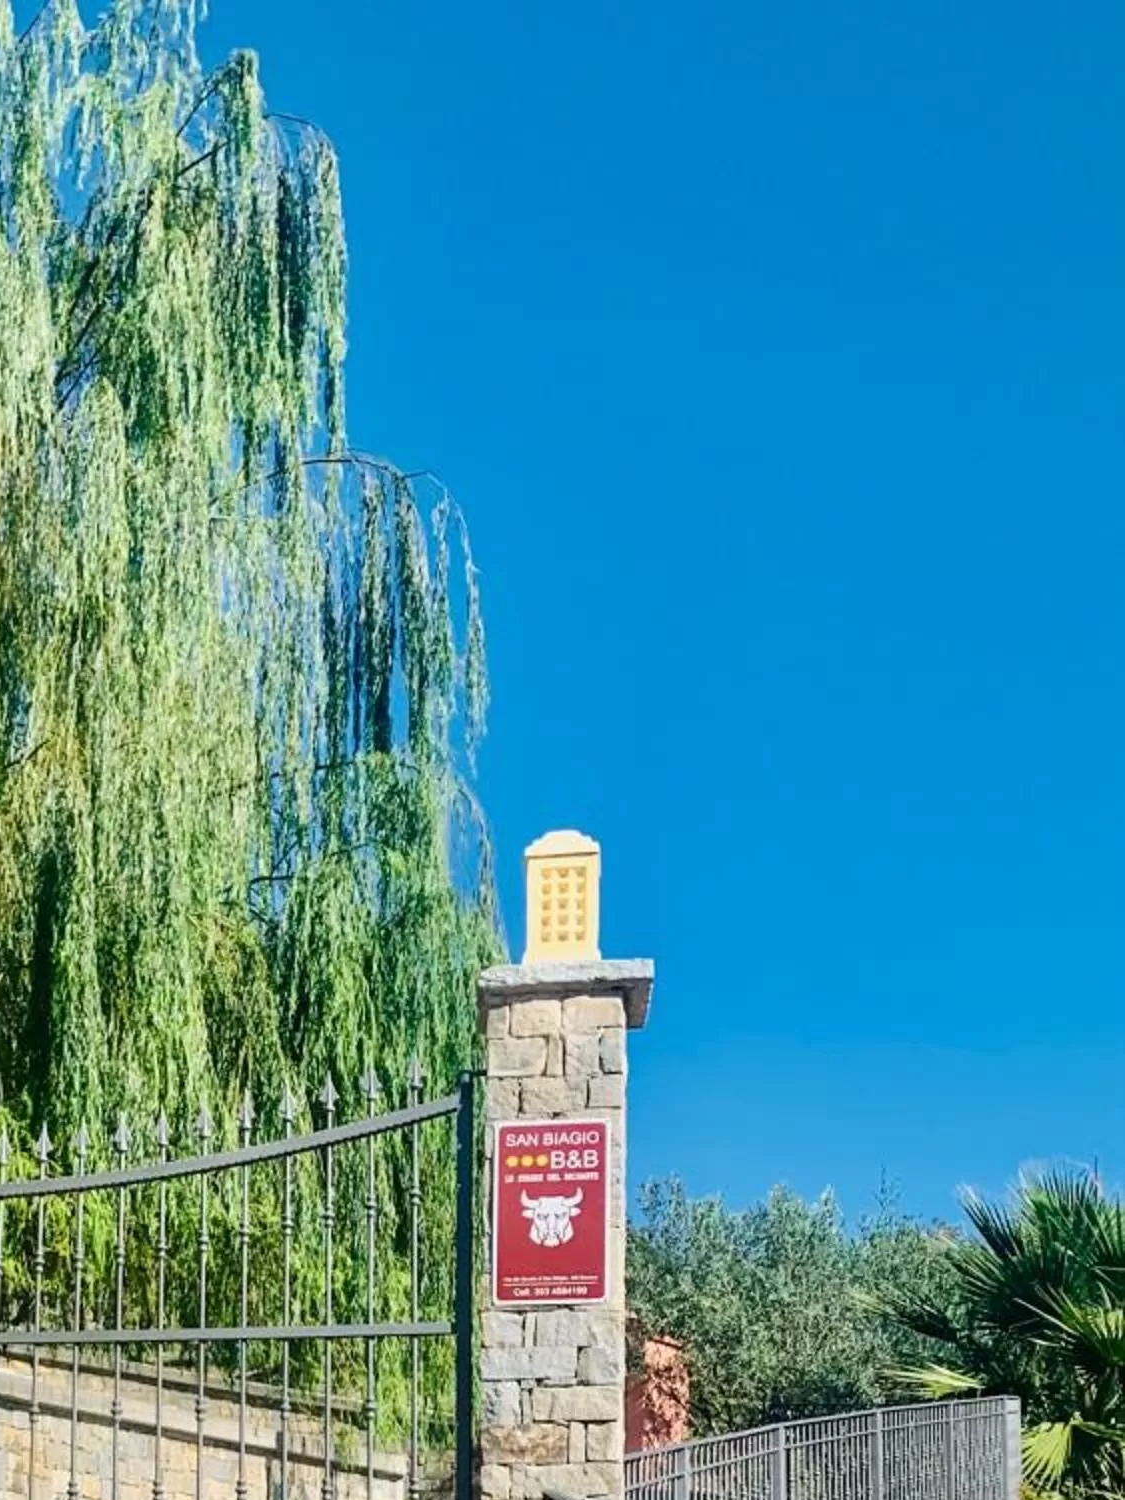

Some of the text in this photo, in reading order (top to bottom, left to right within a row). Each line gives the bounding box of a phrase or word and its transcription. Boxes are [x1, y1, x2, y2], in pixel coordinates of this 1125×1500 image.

[506, 1131, 600, 1147] SAN BIAGIO
[550, 1149, 599, 1168] B&B
